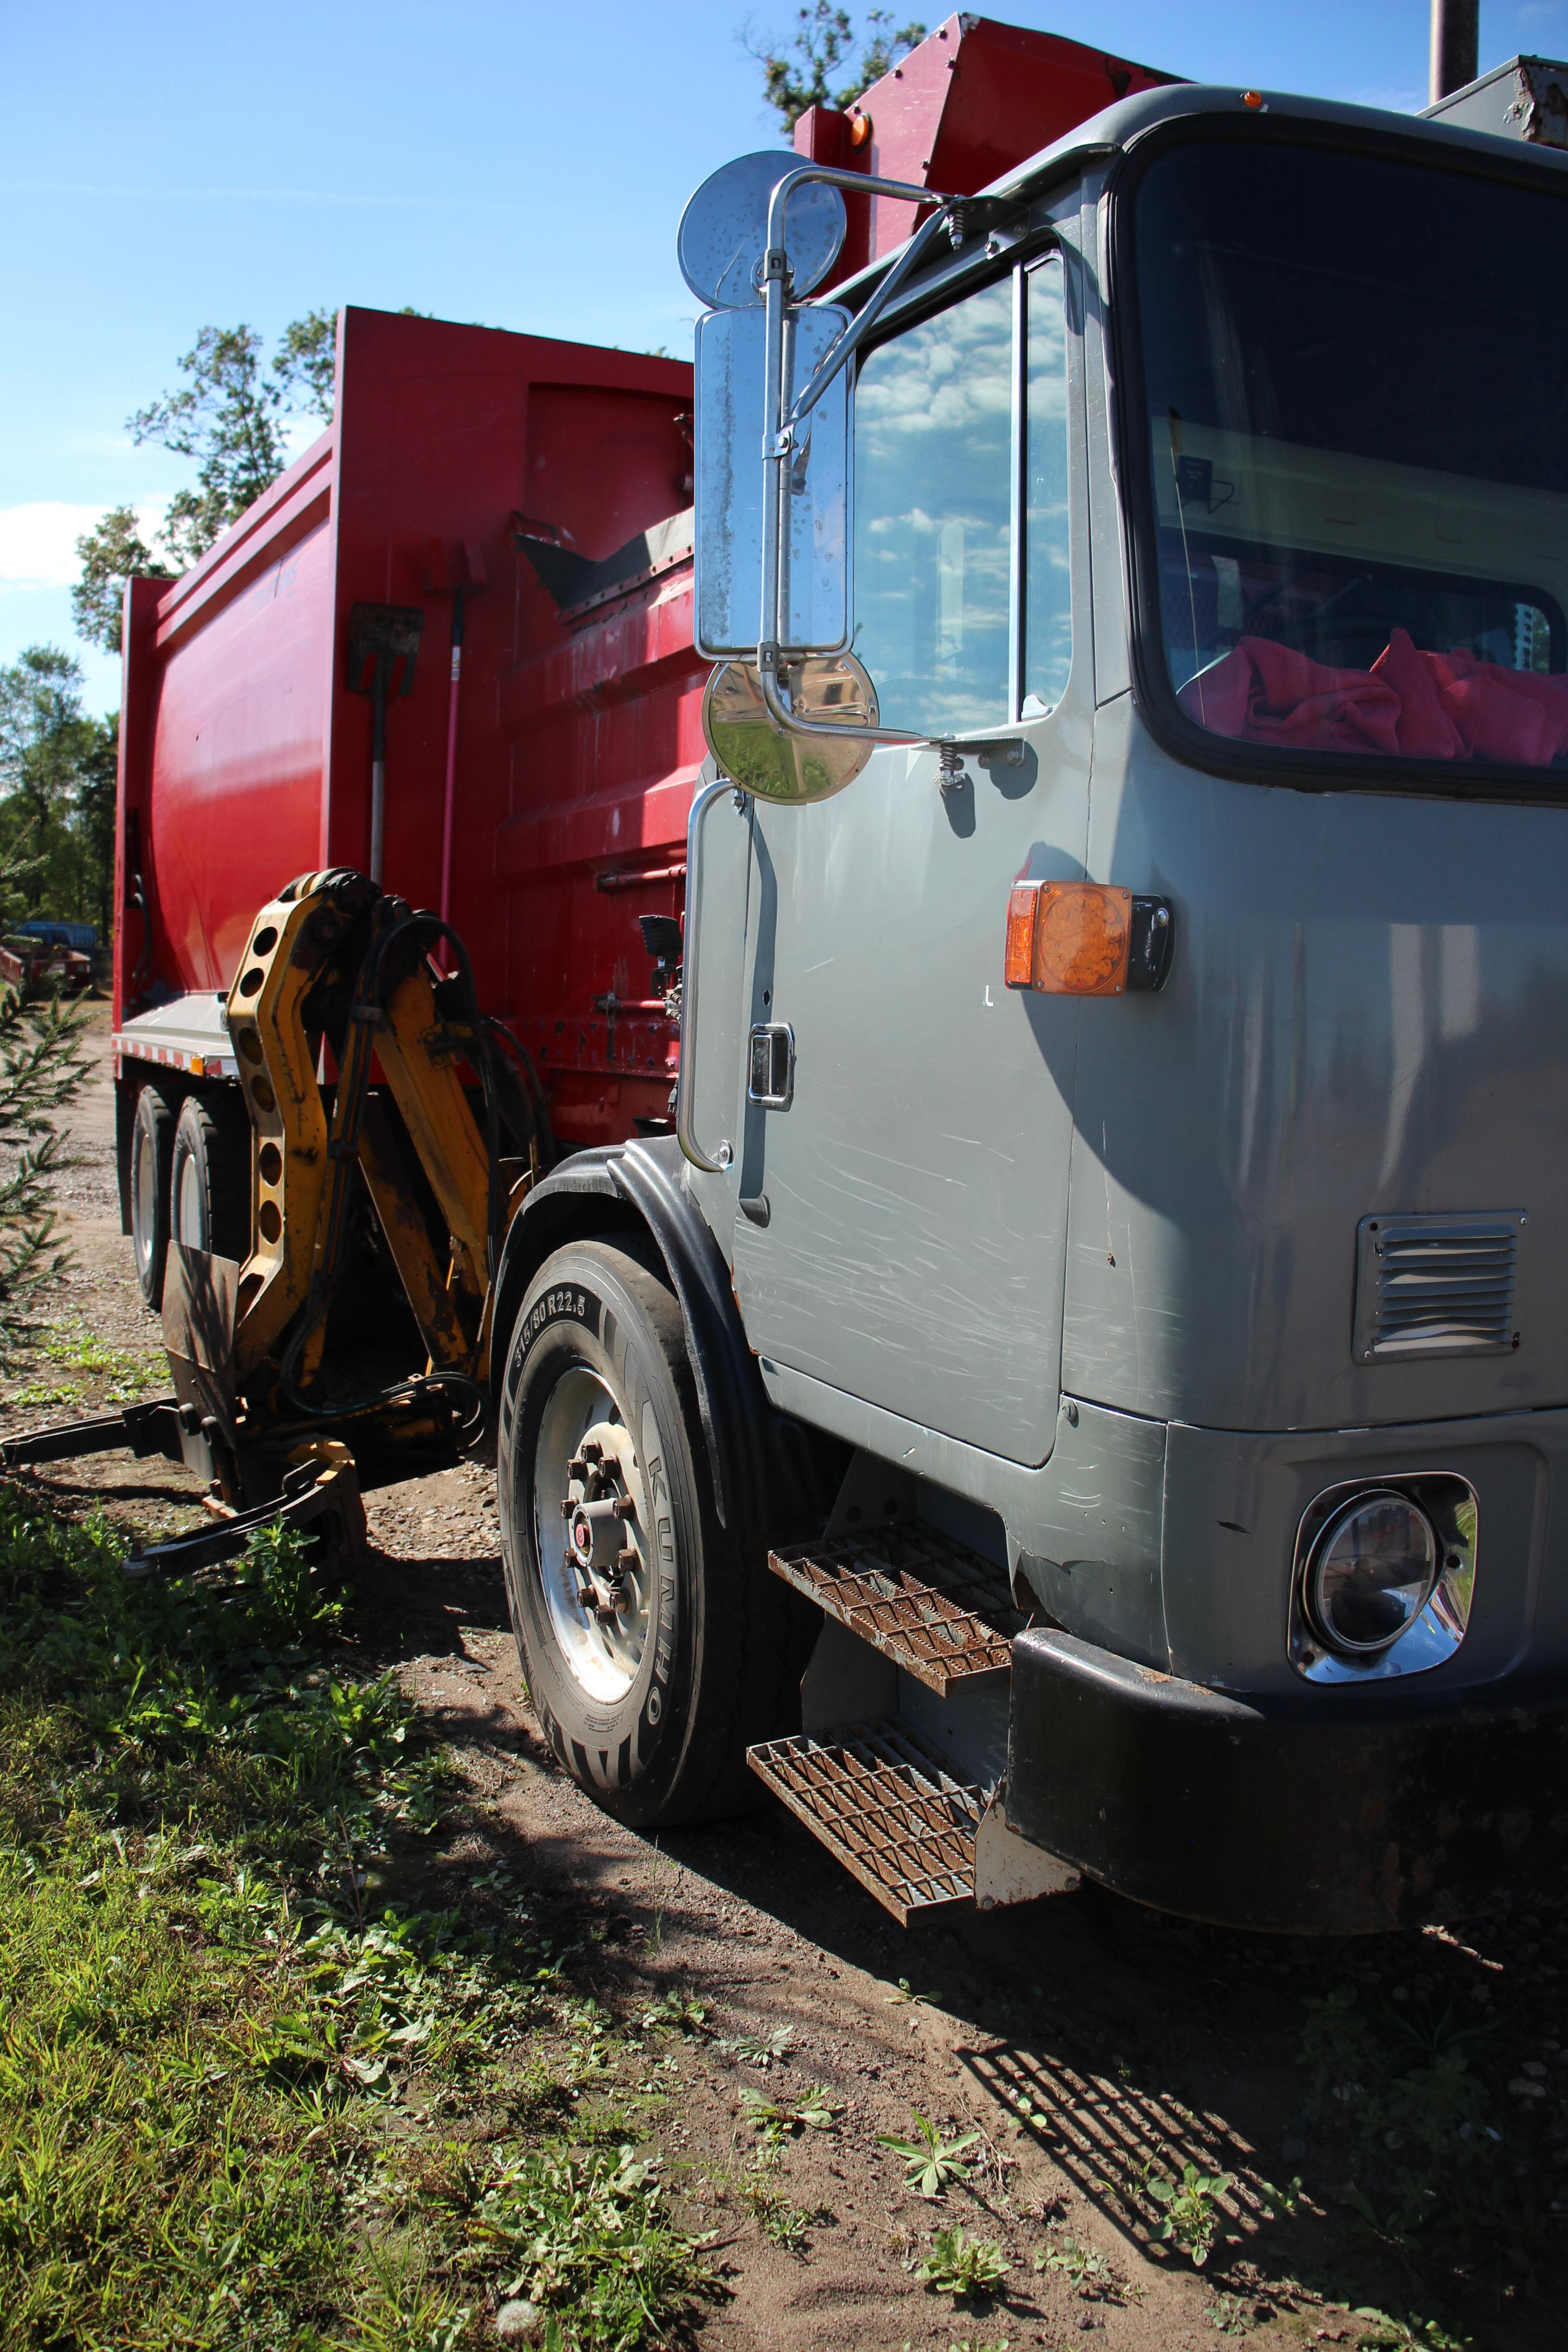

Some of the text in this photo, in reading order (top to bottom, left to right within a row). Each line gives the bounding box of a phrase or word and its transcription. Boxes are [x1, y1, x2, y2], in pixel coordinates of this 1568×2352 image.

[515, 1292, 585, 1367] 315/80 R22.5
[648, 1455, 674, 1725] KUMHO
